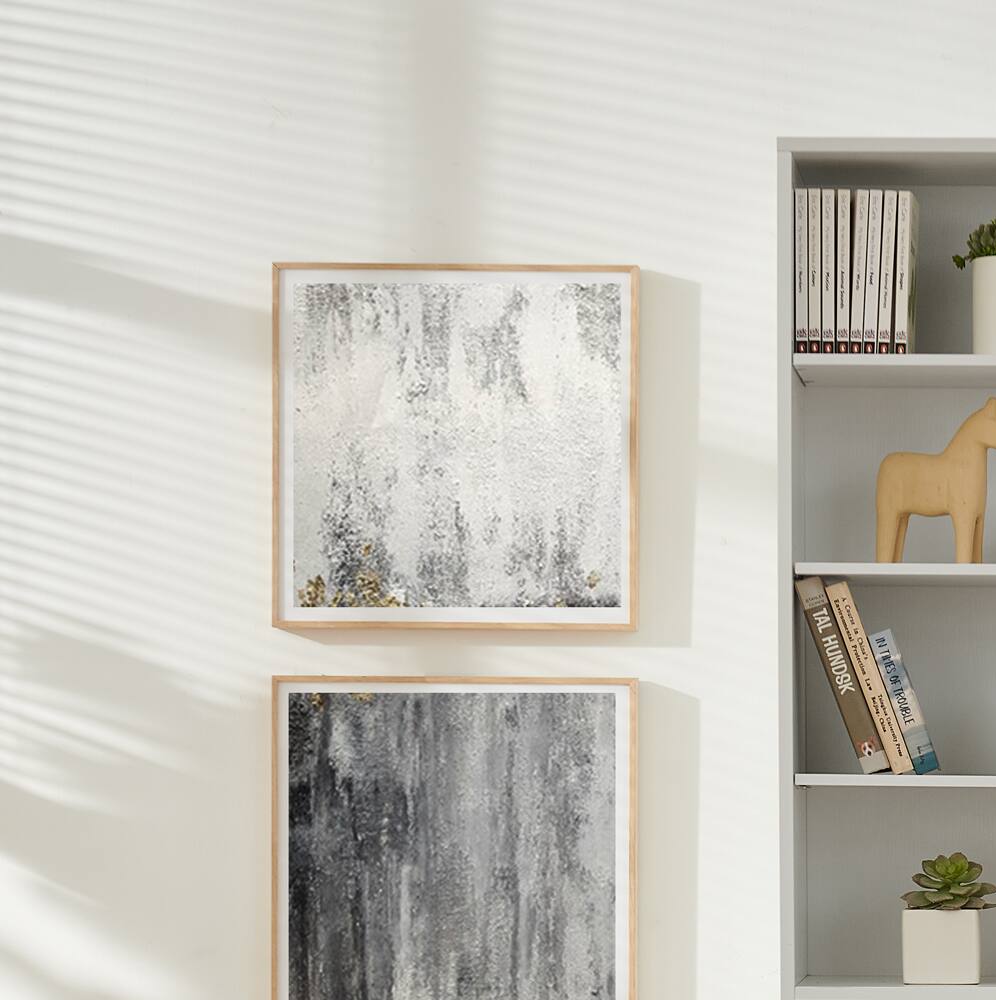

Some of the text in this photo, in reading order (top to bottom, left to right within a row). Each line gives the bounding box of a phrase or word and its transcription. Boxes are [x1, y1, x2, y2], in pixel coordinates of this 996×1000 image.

[812, 607, 832, 633] TAL
[822, 634, 855, 695] HUNDSK
[834, 599, 854, 642] Environmental
[852, 644, 866, 675] Protection
[845, 604, 855, 625] Course
[858, 637, 868, 660] China's
[875, 636, 915, 725] IN TIMES OF TROUBLE
[886, 717, 897, 742] University
